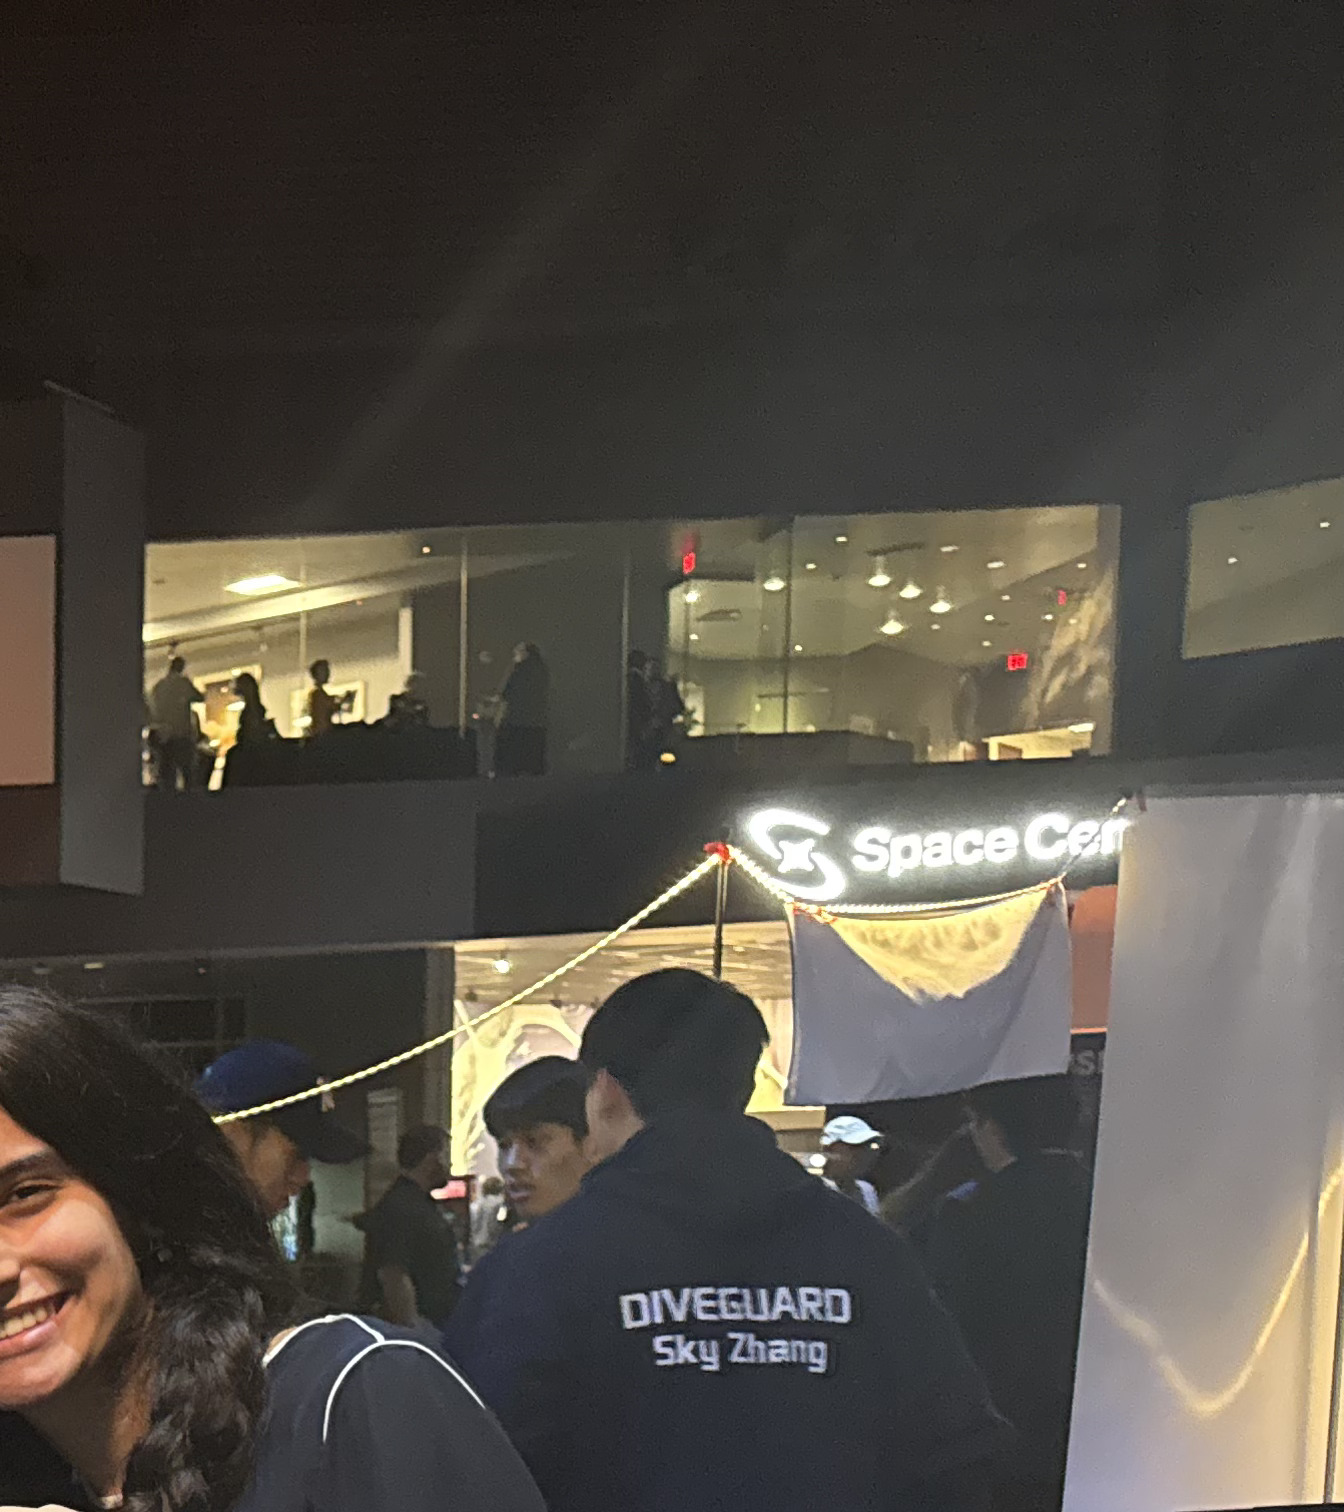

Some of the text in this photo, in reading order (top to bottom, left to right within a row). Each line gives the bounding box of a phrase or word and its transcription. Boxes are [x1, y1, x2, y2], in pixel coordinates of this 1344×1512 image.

[853, 826, 1019, 878] Space
[619, 1286, 853, 1330] DIVEGUARD
[652, 1332, 829, 1374] Sky Zhang
